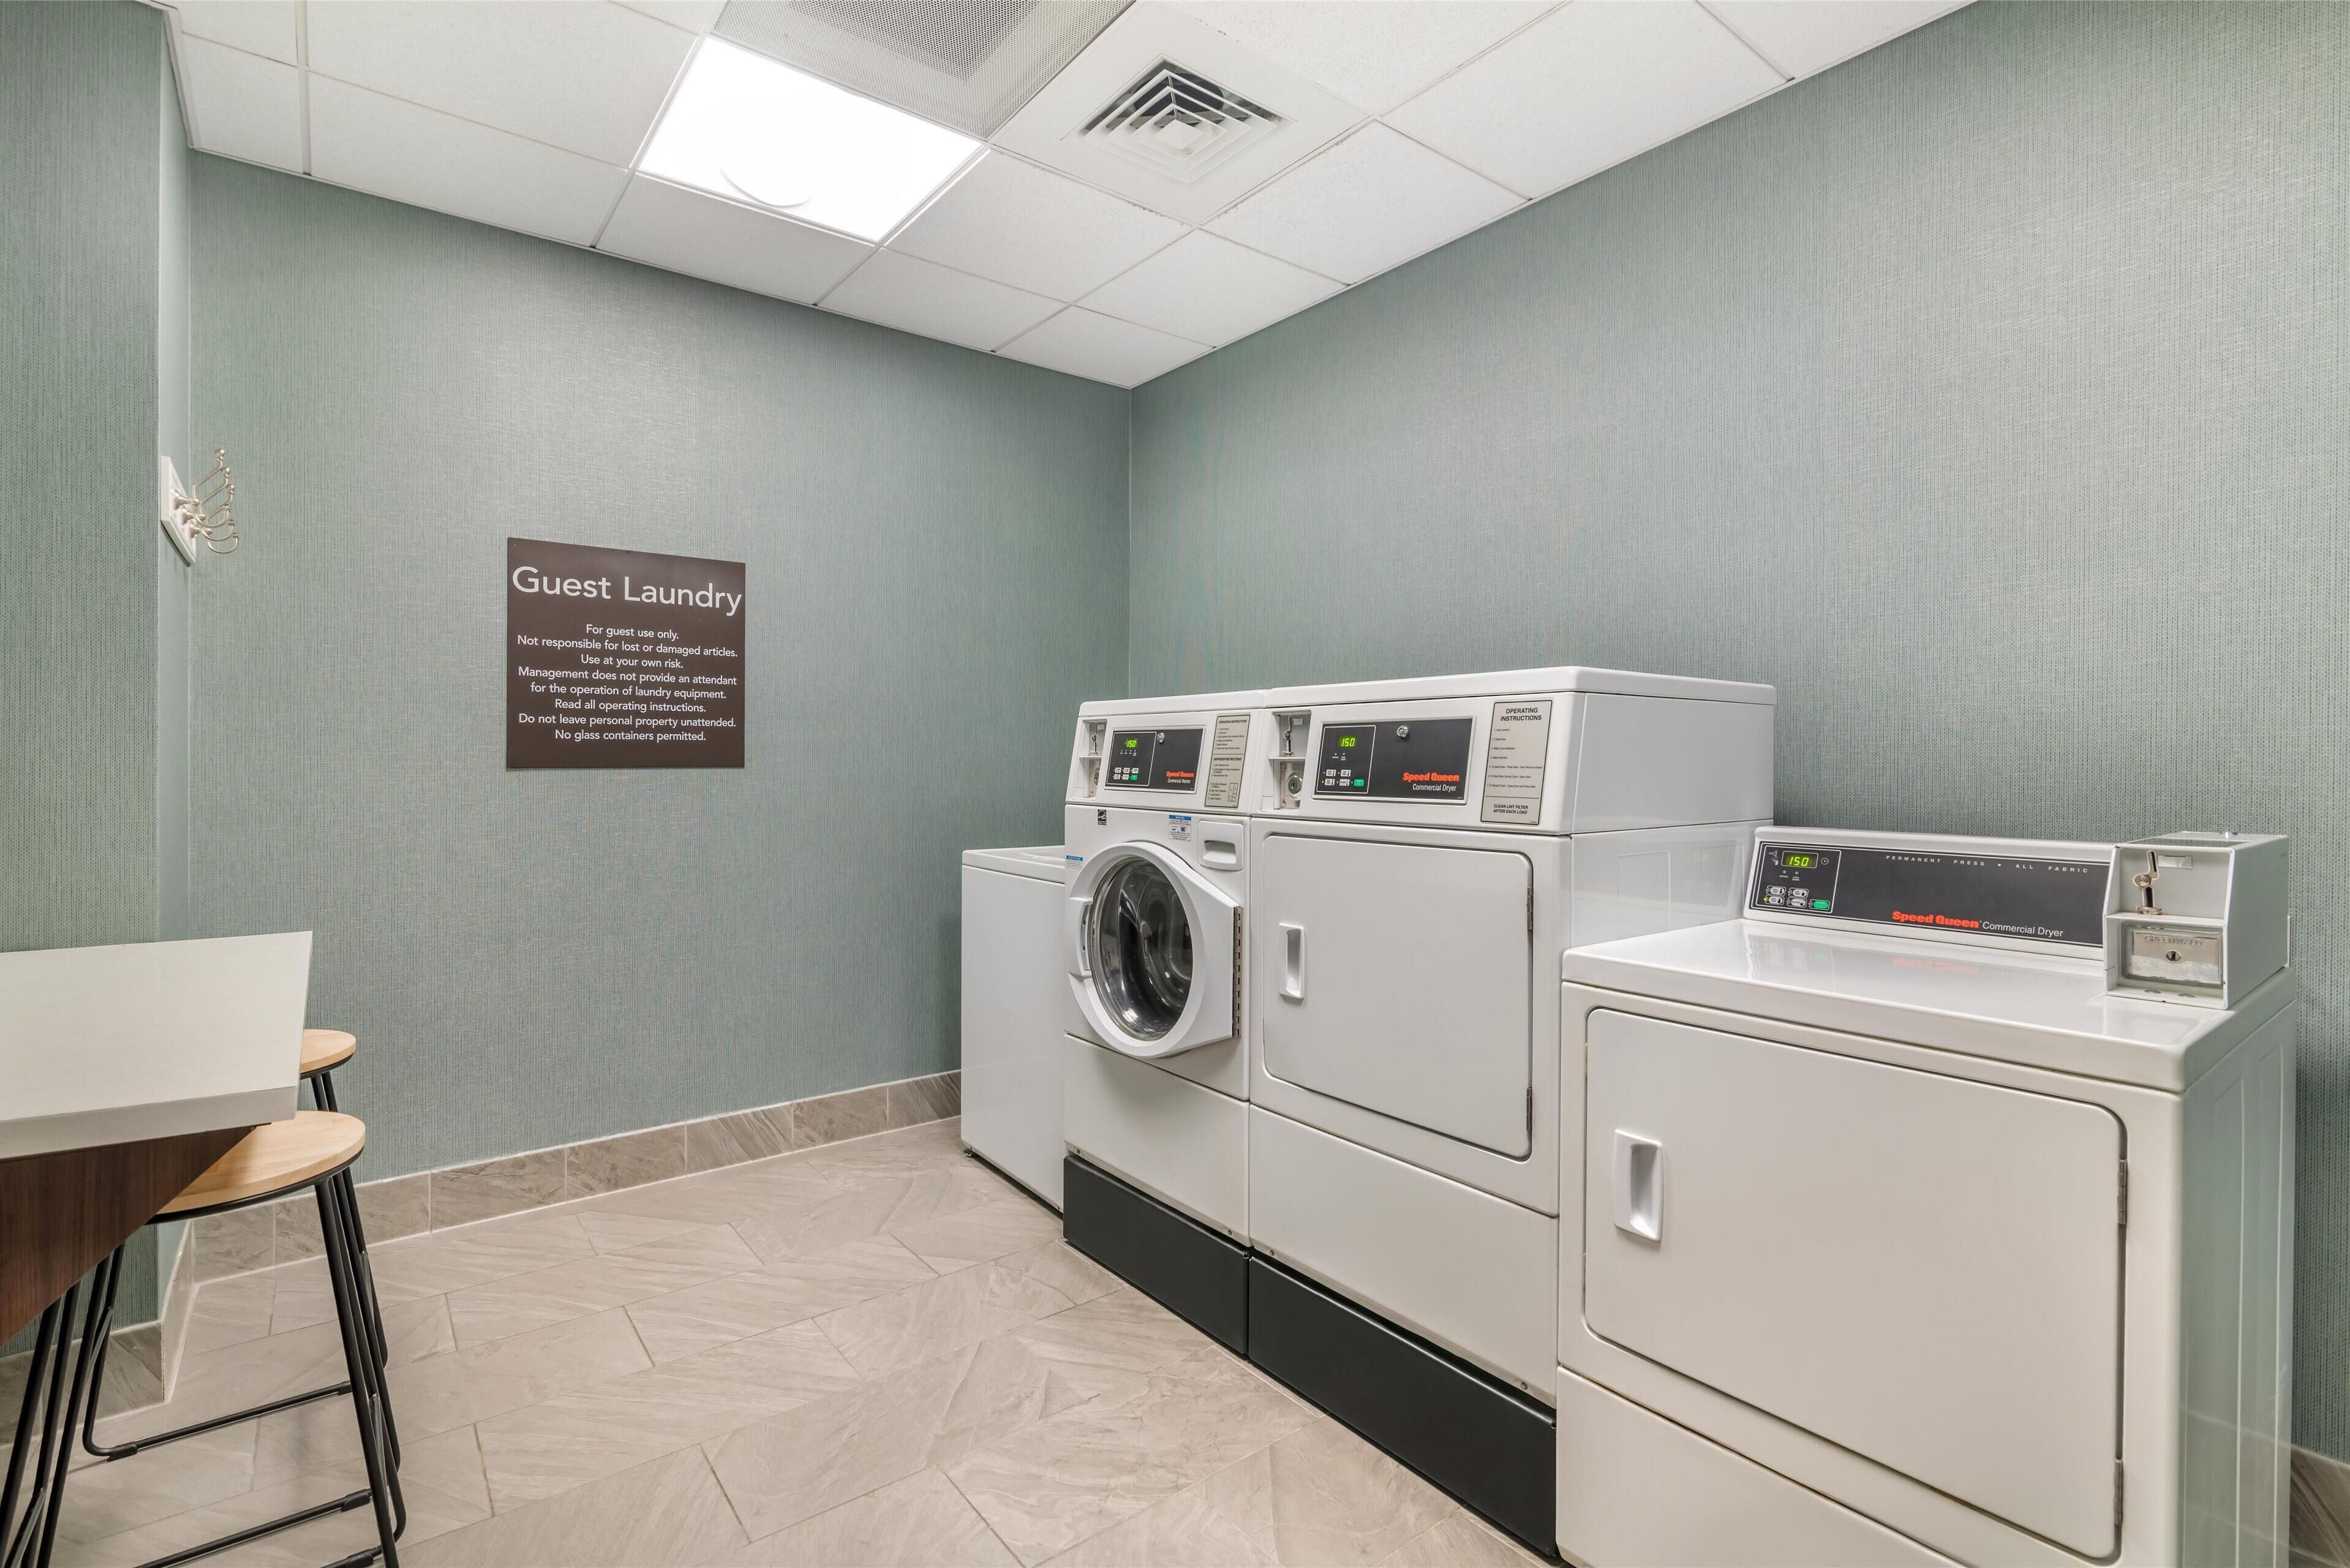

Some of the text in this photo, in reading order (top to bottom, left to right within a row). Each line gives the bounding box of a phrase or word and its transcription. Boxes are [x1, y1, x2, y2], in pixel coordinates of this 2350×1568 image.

[513, 567, 742, 616] Guest Laundry
[587, 624, 603, 634] For
[606, 628, 634, 637] guest
[658, 630, 679, 641] only.
[518, 635, 737, 657] Not responsible for lost or damaged articles.
[581, 654, 600, 664] Use
[616, 658, 638, 667] your
[665, 658, 683, 668] risk.
[519, 666, 589, 679] Management
[592, 669, 616, 680] does
[640, 673, 676, 684] provide
[693, 675, 737, 685] attendant
[530, 682, 726, 700] for the operation of laundry equipment.
[555, 699, 706, 713] Read all operating instructions.
[519, 714, 535, 723] Do
[560, 714, 586, 724] leave
[590, 715, 632, 727] personal
[636, 718, 678, 728] property
[681, 718, 736, 726] unattended.
[555, 729, 706, 743] No glass containers permitted.
[1342, 738, 1355, 747] 150
[1403, 772, 1459, 782] Speed Queen
[1790, 857, 1809, 866] 150
[1892, 911, 2063, 938] Speed Queen Commercial Dryer
